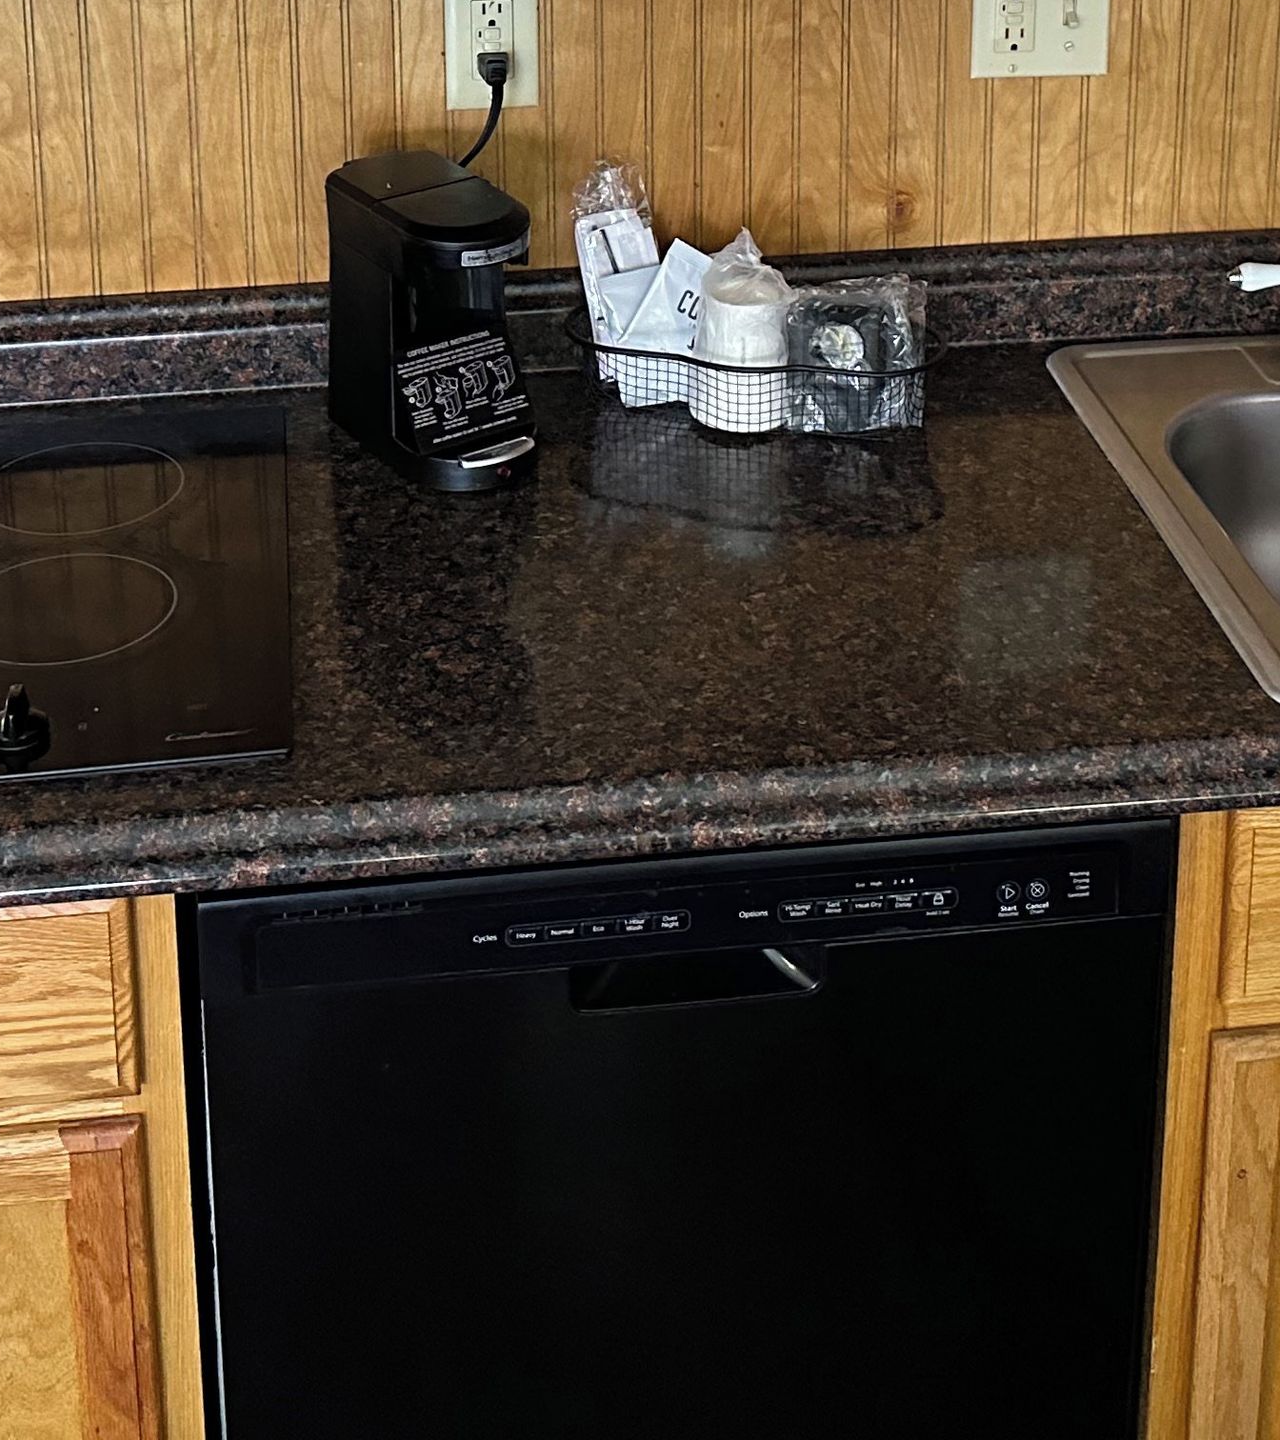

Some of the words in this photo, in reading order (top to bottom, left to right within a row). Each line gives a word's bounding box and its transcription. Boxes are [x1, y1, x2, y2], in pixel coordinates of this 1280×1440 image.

[739, 910, 768, 919] Options
[550, 928, 574, 936] Normal
[472, 934, 497, 944] Cycles
